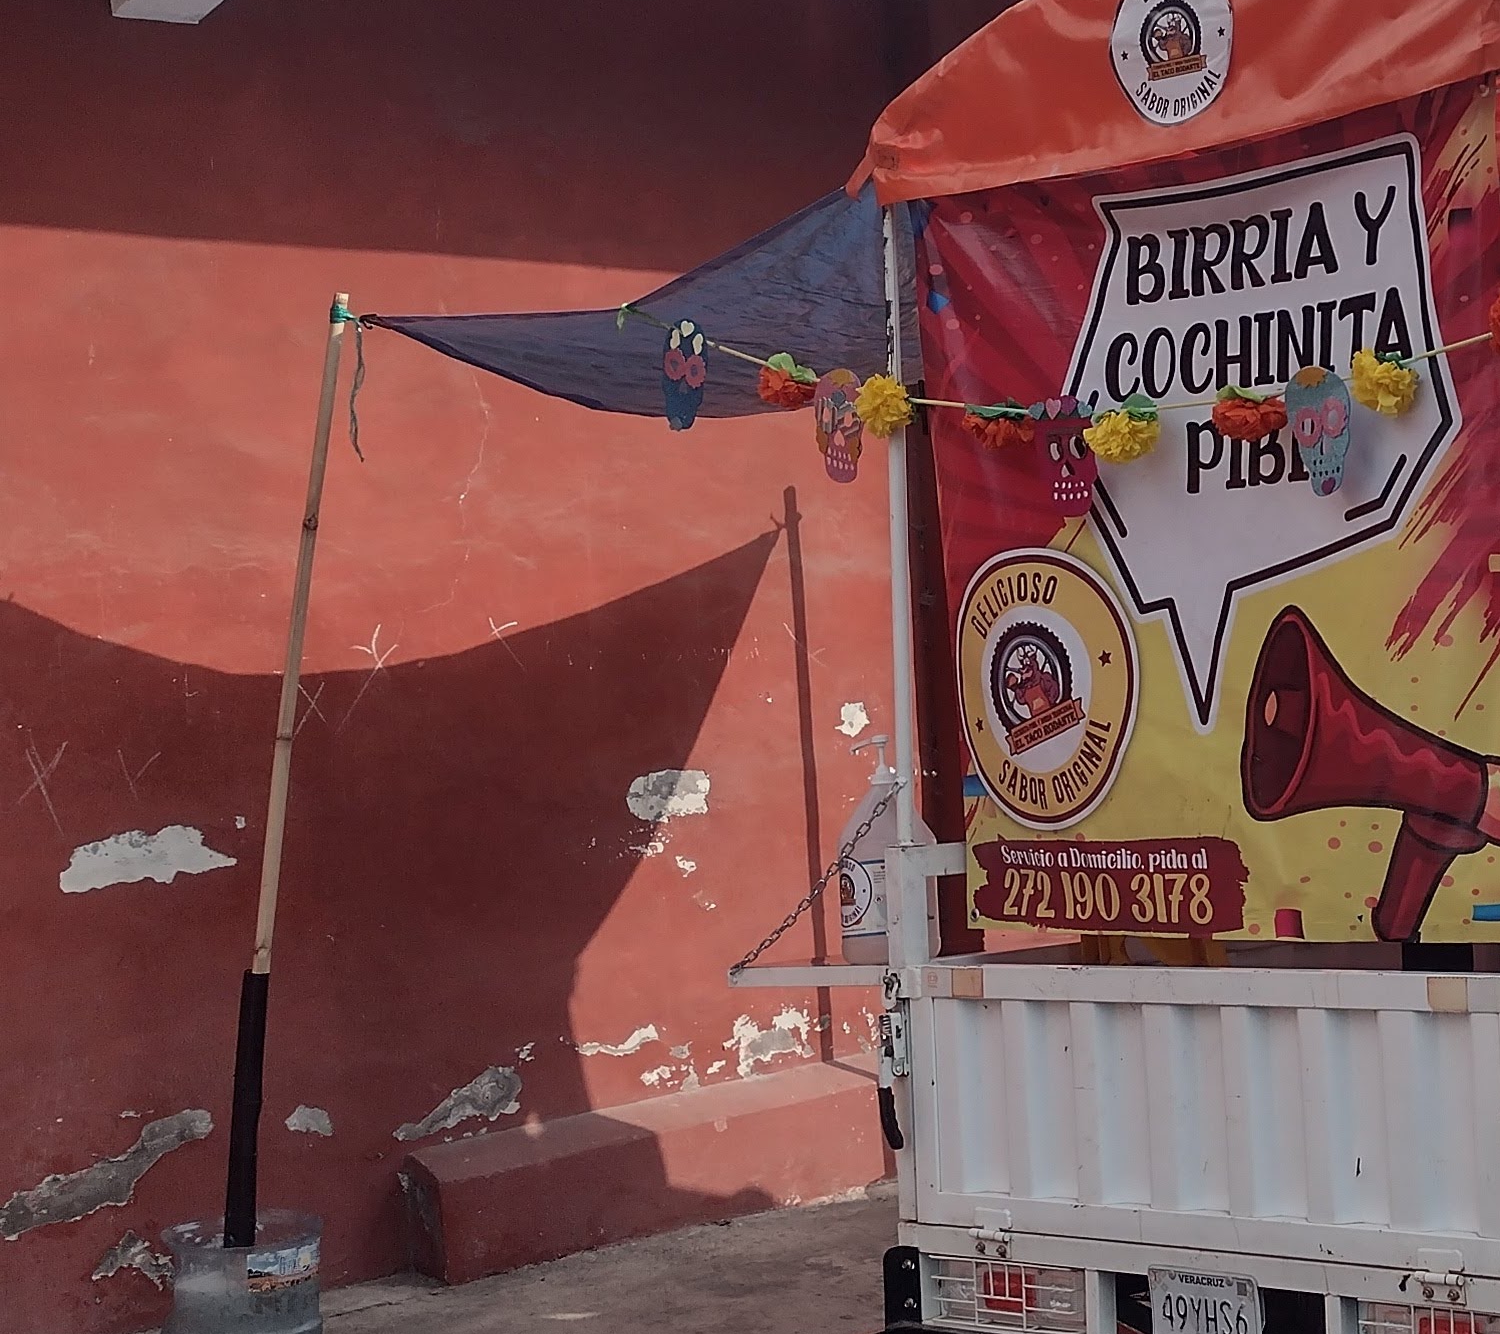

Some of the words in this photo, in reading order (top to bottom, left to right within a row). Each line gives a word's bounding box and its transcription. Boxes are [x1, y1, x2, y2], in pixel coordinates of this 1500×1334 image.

[1135, 81, 1170, 118] SABOR
[1173, 69, 1222, 117] ORIGINAL
[1126, 202, 1339, 306] BIRRIA
[1354, 185, 1397, 266] Y
[1105, 286, 1412, 399] COCHINITA
[970, 571, 1058, 640] DELICIOSO
[998, 759, 1048, 810] SABOR
[1053, 717, 1112, 805] ORIGINAL
[1001, 845, 1055, 867] Servicio
[1058, 851, 1068, 867] a
[1149, 848, 1188, 873] pida
[1191, 848, 1208, 869] al
[1003, 868, 1055, 918] 272
[1060, 871, 1121, 922] 190
[1130, 873, 1214, 925] 3178
[1178, 1274, 1225, 1288] VERACRUZ
